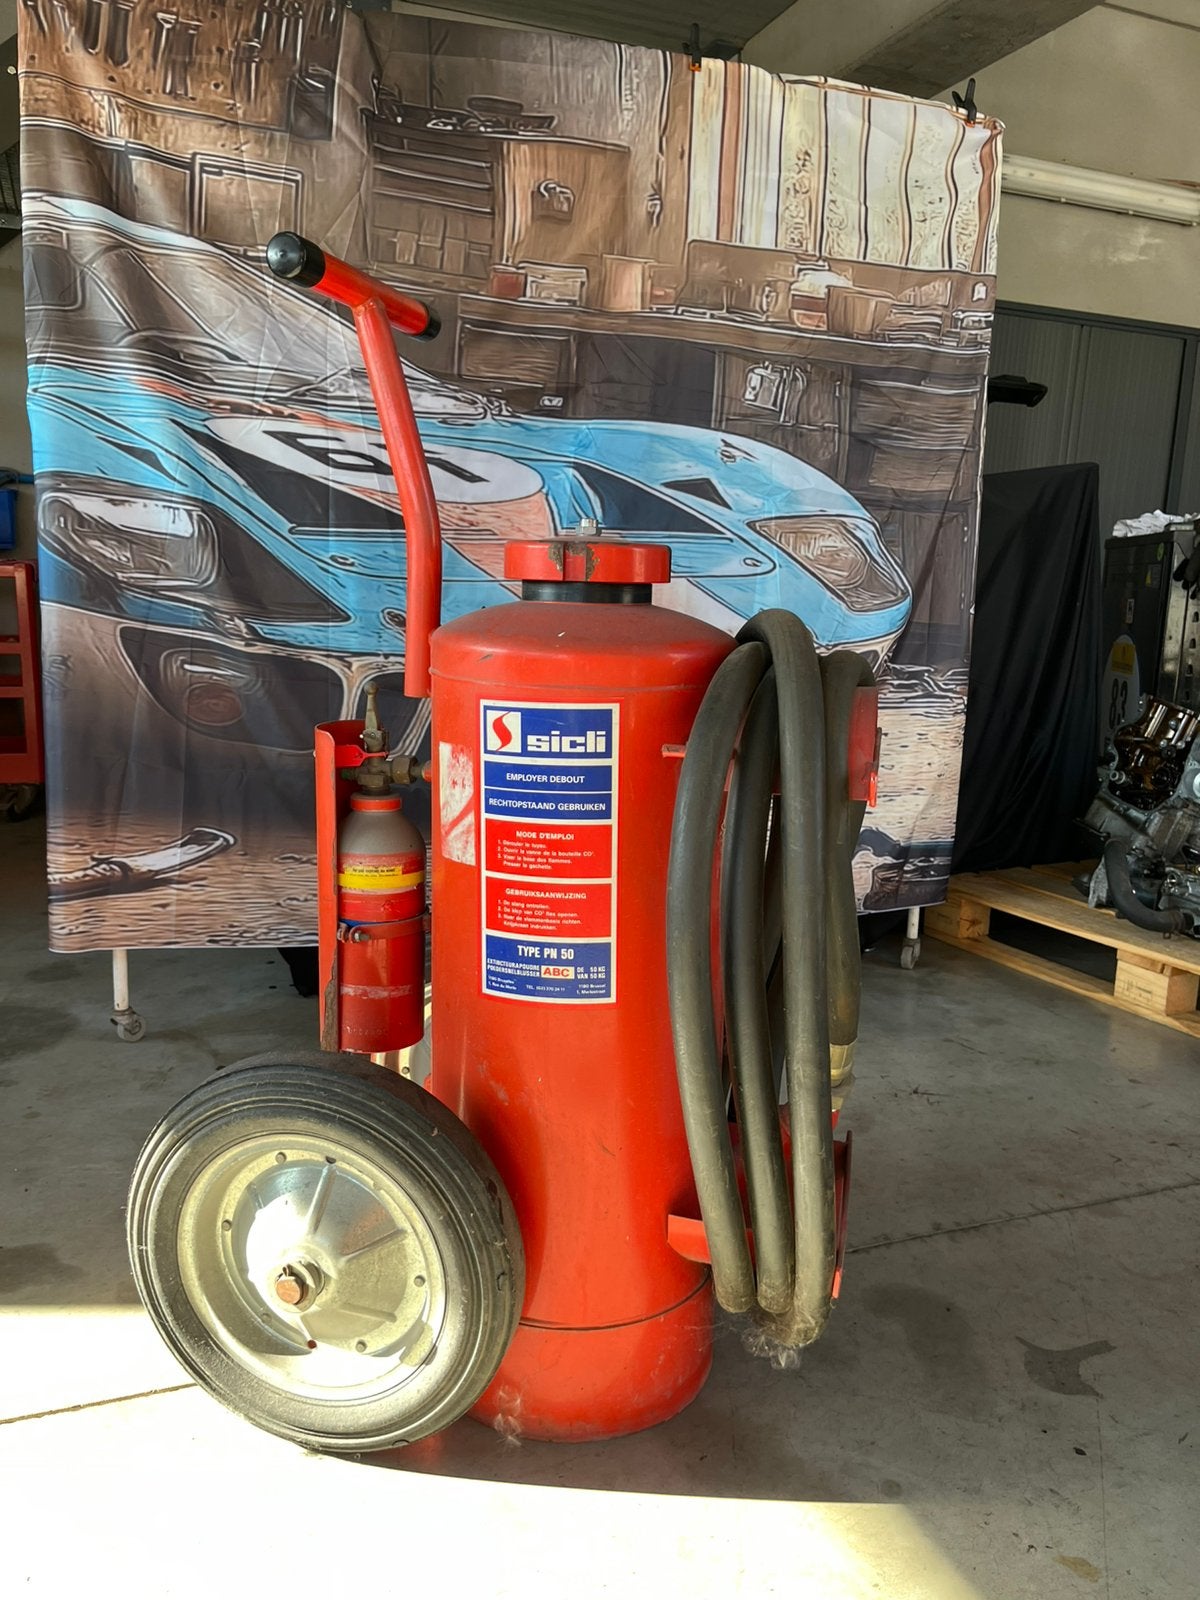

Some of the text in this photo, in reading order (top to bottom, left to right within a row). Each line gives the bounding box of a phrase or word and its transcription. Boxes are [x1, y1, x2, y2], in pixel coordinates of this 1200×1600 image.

[527, 730, 606, 752] sicli
[506, 772, 586, 784] EMPLOYER DEBOUT
[488, 798, 606, 811] RECHTOPSTAAND GEBRUIKEN
[516, 830, 574, 840] MODE D'EMPLOI
[506, 888, 587, 900] GEBRUIKSAANWIJZING
[517, 945, 574, 960] TYPE PN 50
[543, 967, 570, 978] ABC
